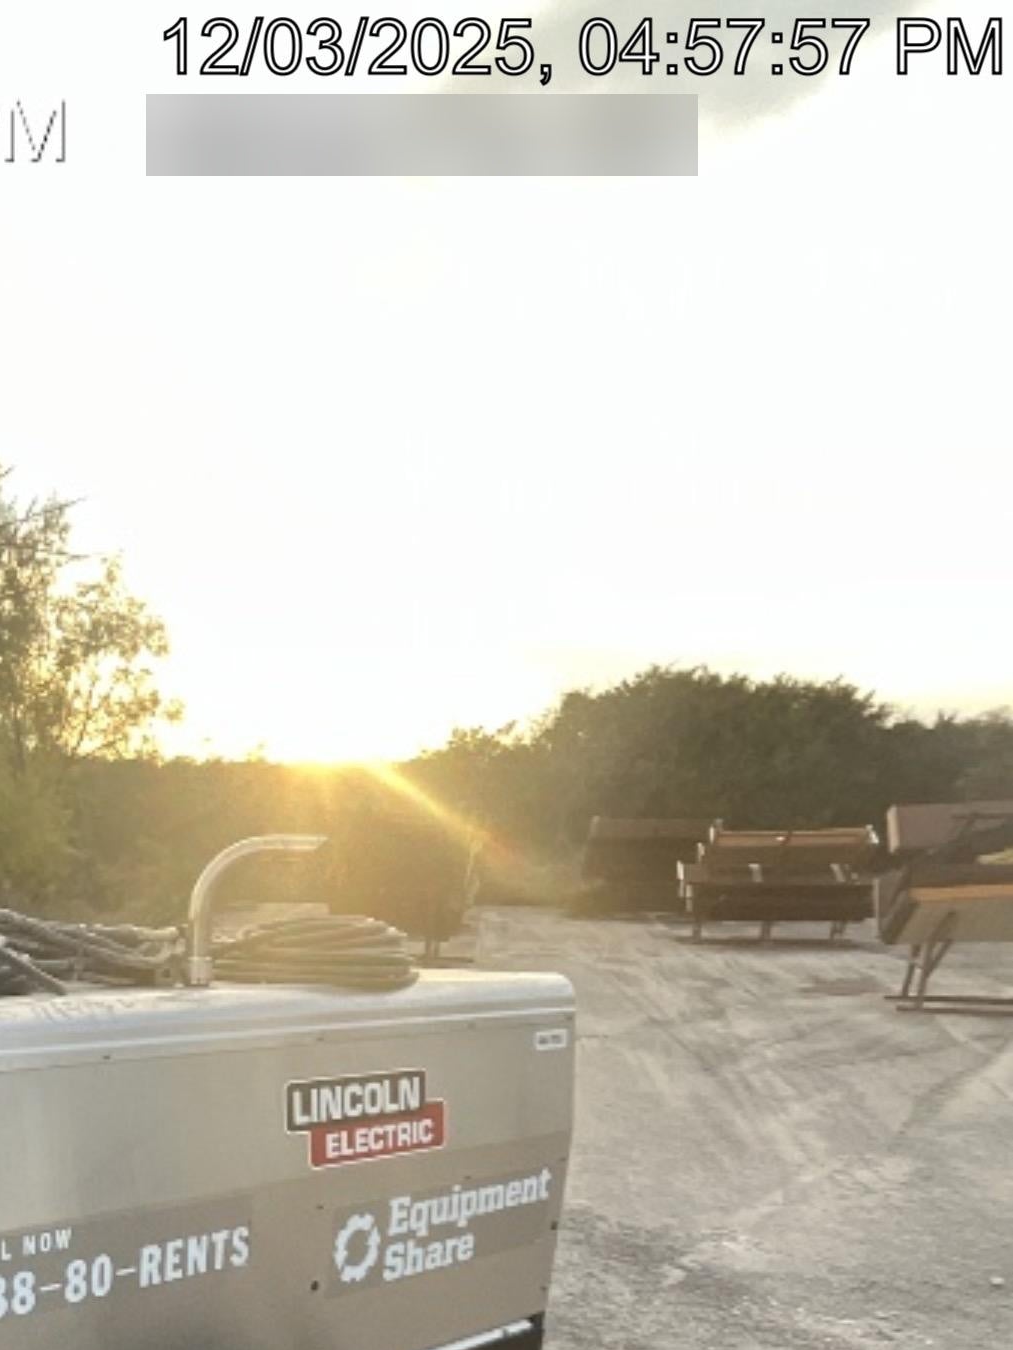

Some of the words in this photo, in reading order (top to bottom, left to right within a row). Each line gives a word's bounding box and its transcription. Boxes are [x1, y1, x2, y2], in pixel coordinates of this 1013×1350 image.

[291, 1076, 421, 1126] LINCOLN
[324, 1118, 435, 1159] ELECTRIC
[387, 1168, 552, 1237] Equipment
[22, 1226, 73, 1257] NOW
[382, 1233, 475, 1282] Share
